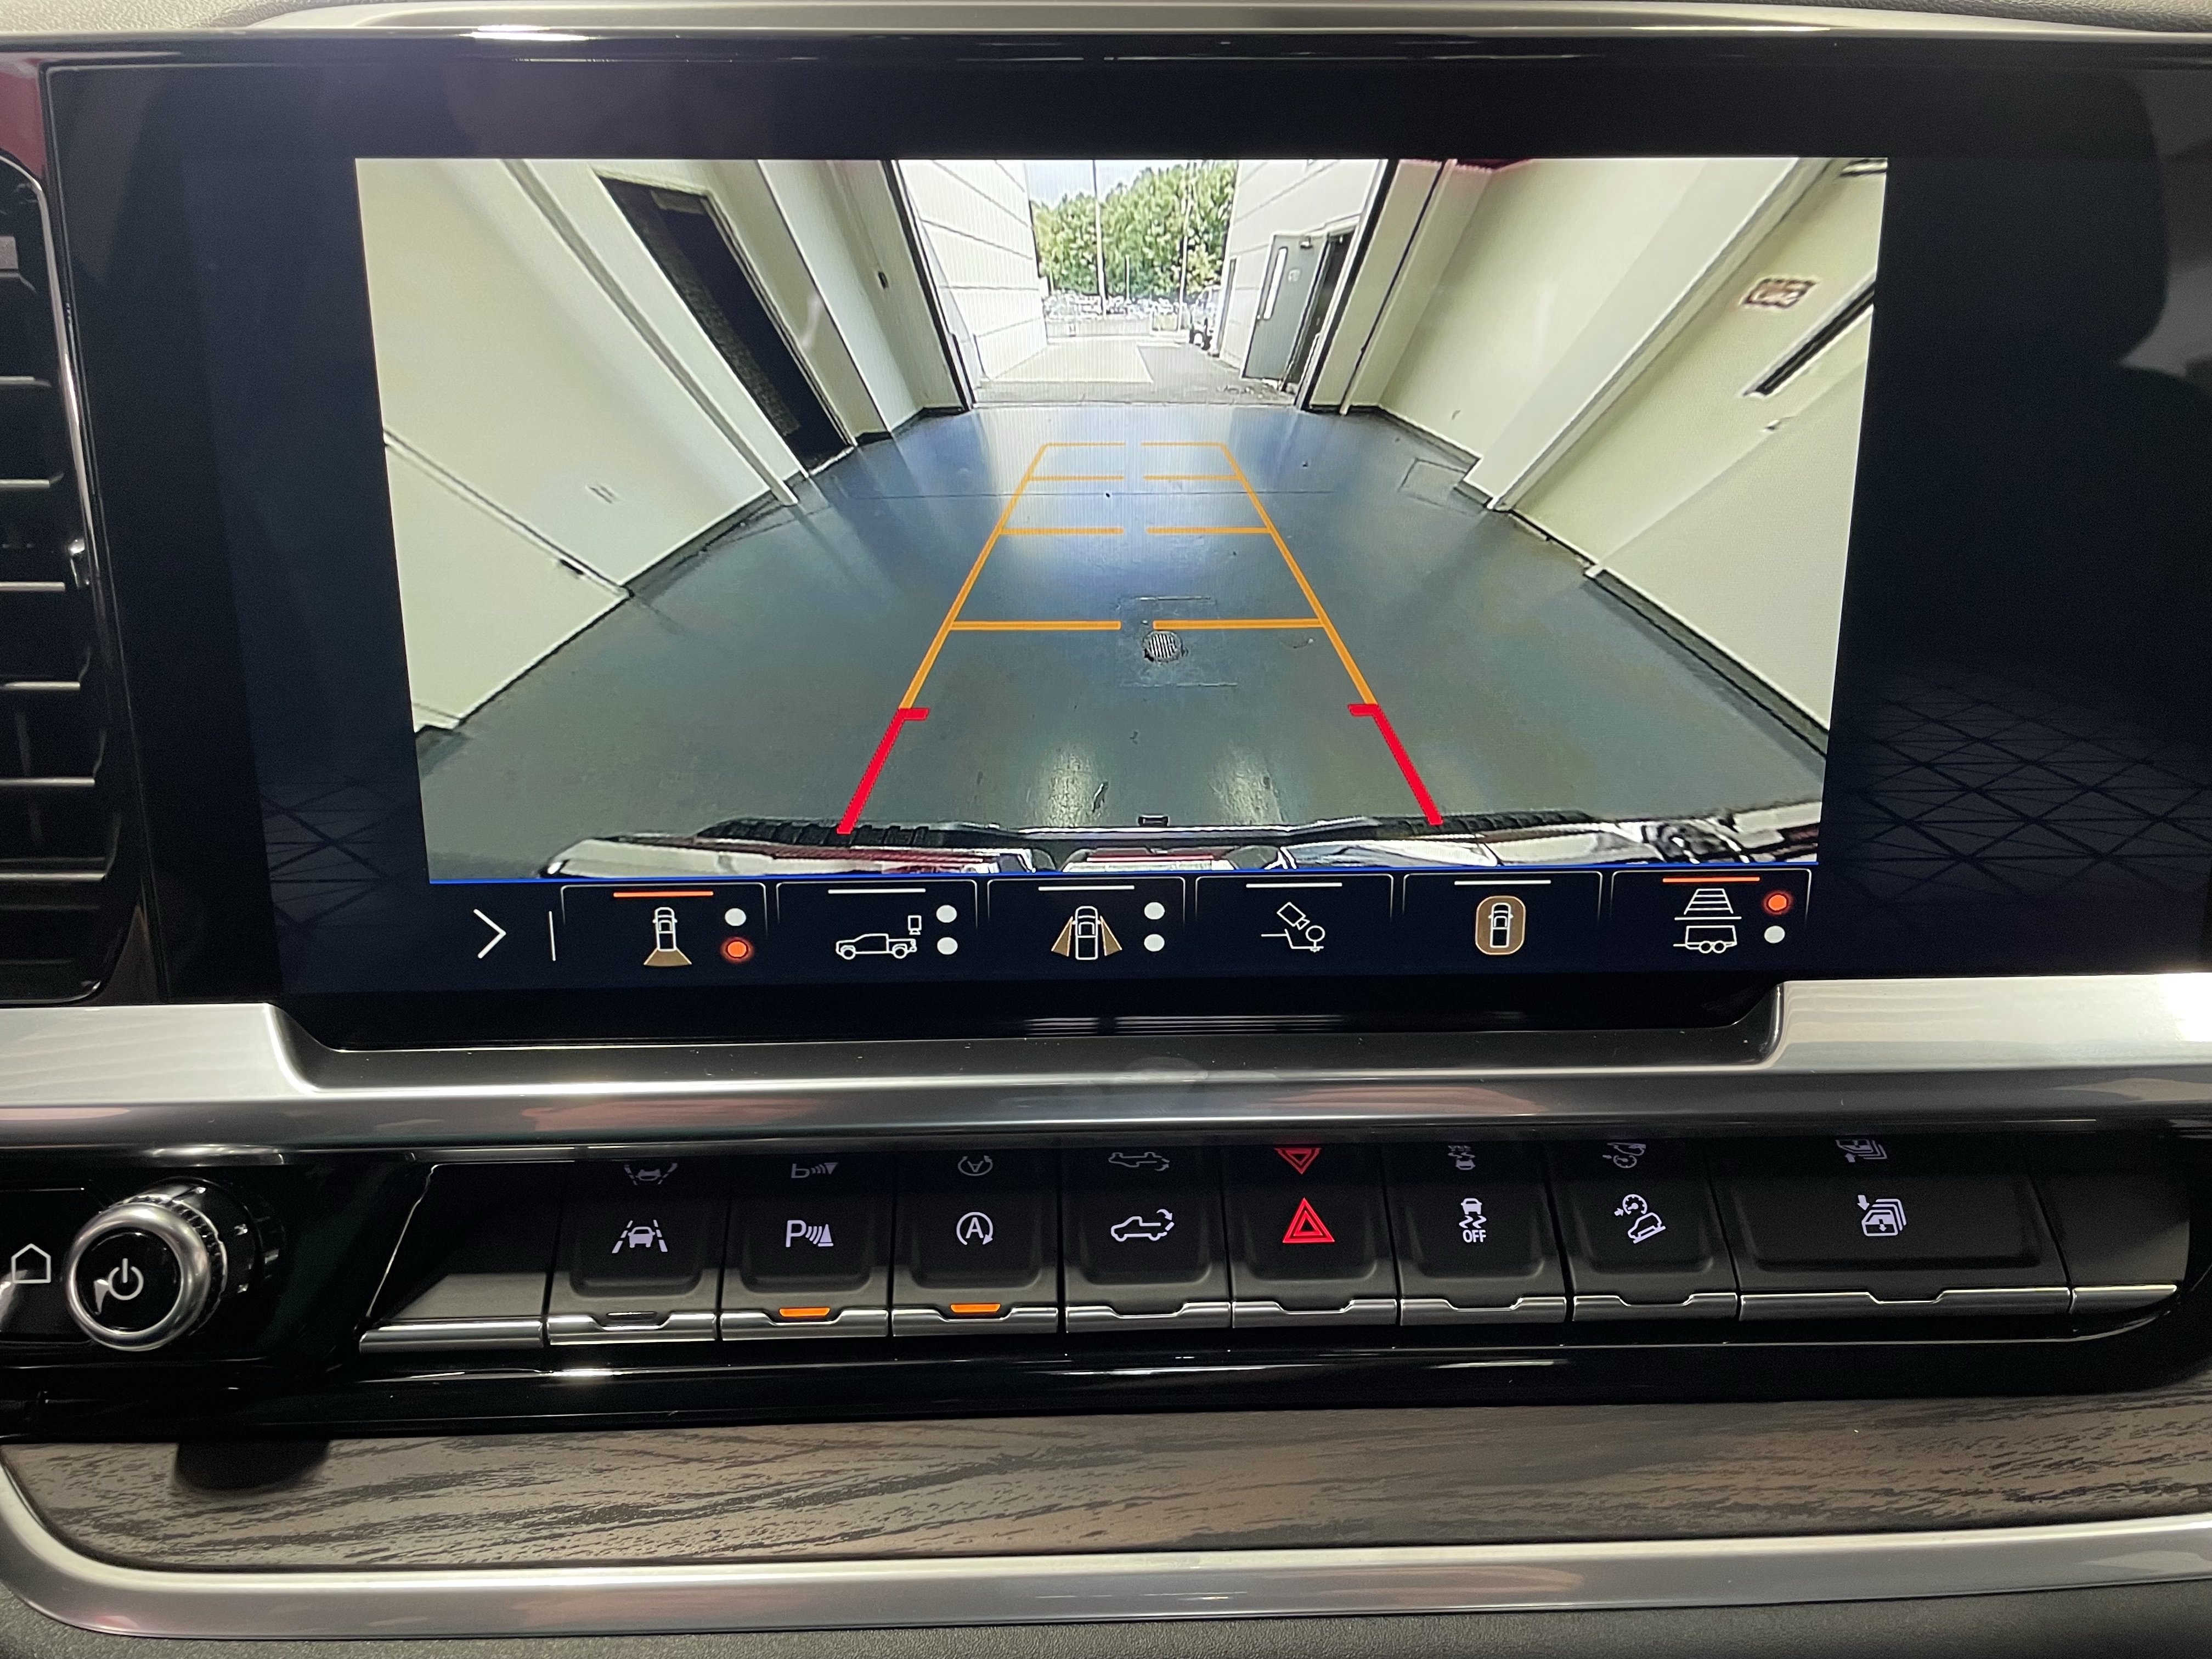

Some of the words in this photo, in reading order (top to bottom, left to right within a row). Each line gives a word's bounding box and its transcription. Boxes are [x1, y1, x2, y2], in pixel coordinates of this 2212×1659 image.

[785, 1220, 806, 1248] P
[965, 1217, 984, 1239] A
[1463, 1229, 1487, 1243] OFF
